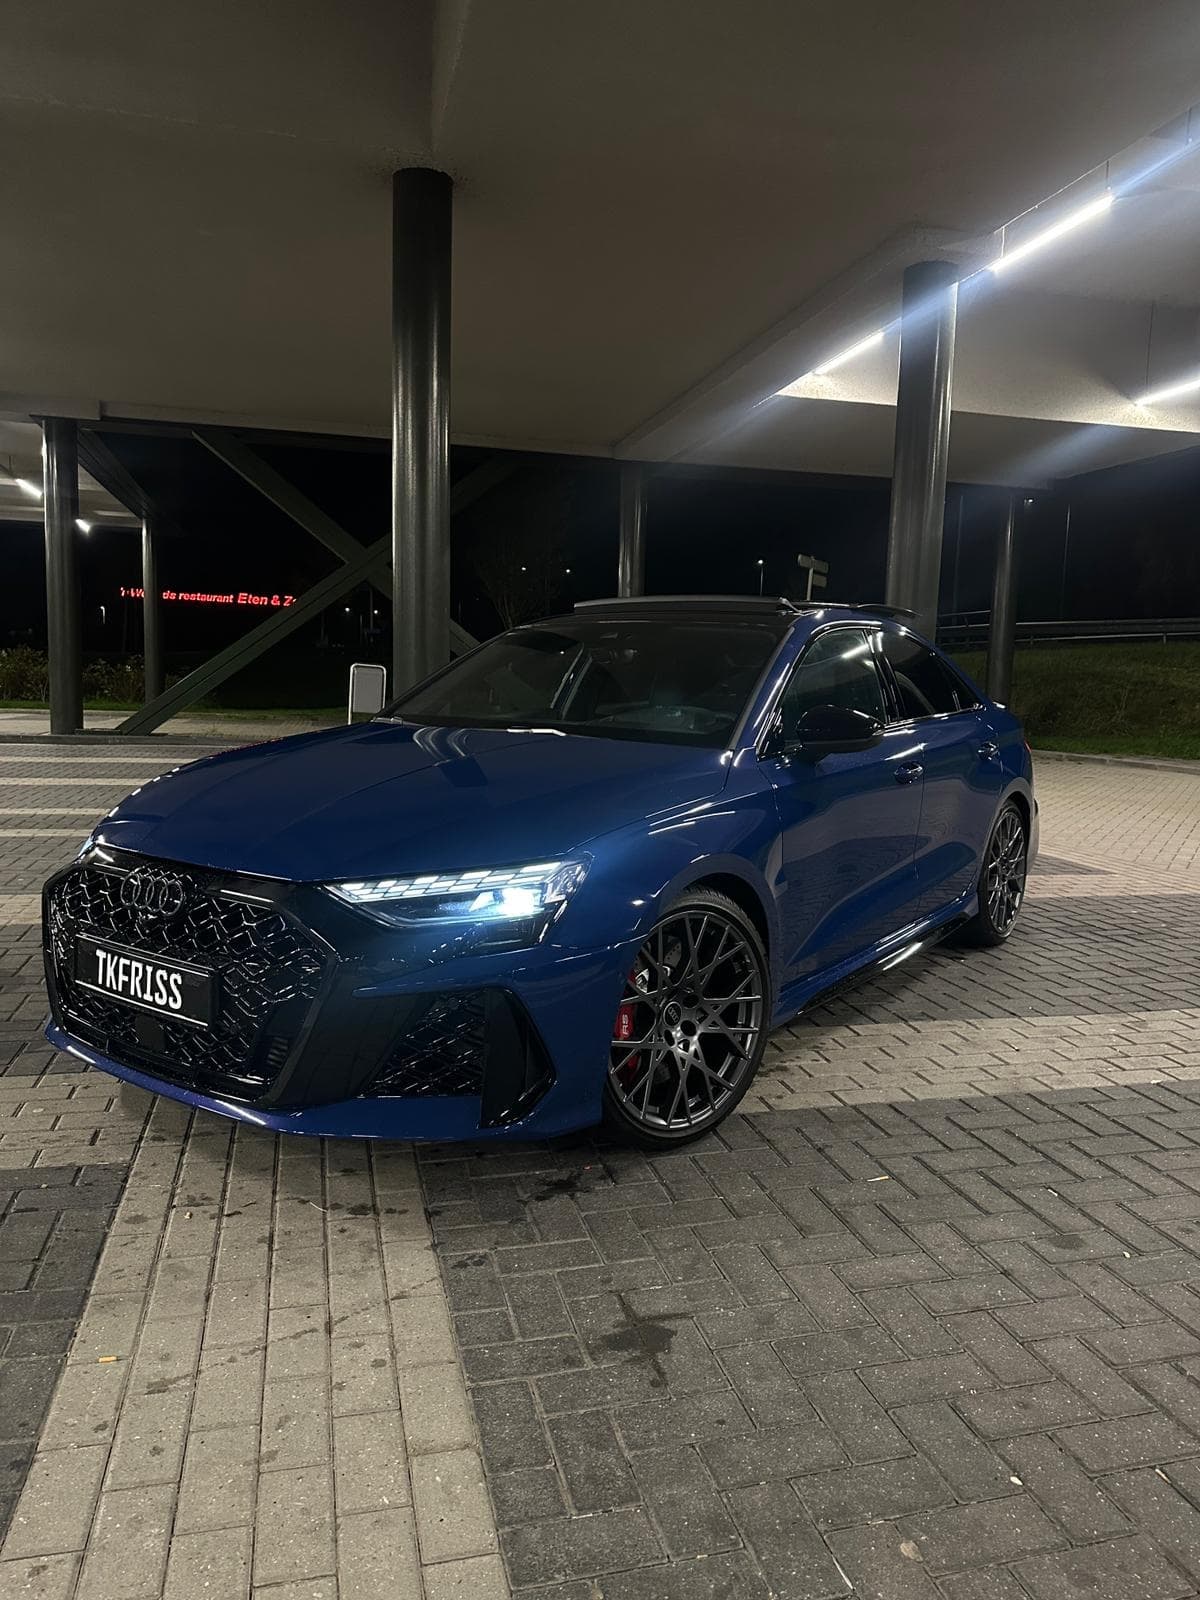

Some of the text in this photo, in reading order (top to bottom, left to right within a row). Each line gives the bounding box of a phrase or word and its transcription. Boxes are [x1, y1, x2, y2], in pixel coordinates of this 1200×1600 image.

[178, 592, 234, 603] restaurant
[237, 592, 268, 605] Eten
[271, 594, 280, 606] &
[283, 595, 297, 607] Z
[95, 949, 182, 1010] TKFRISS
[622, 1014, 629, 1036] RS
